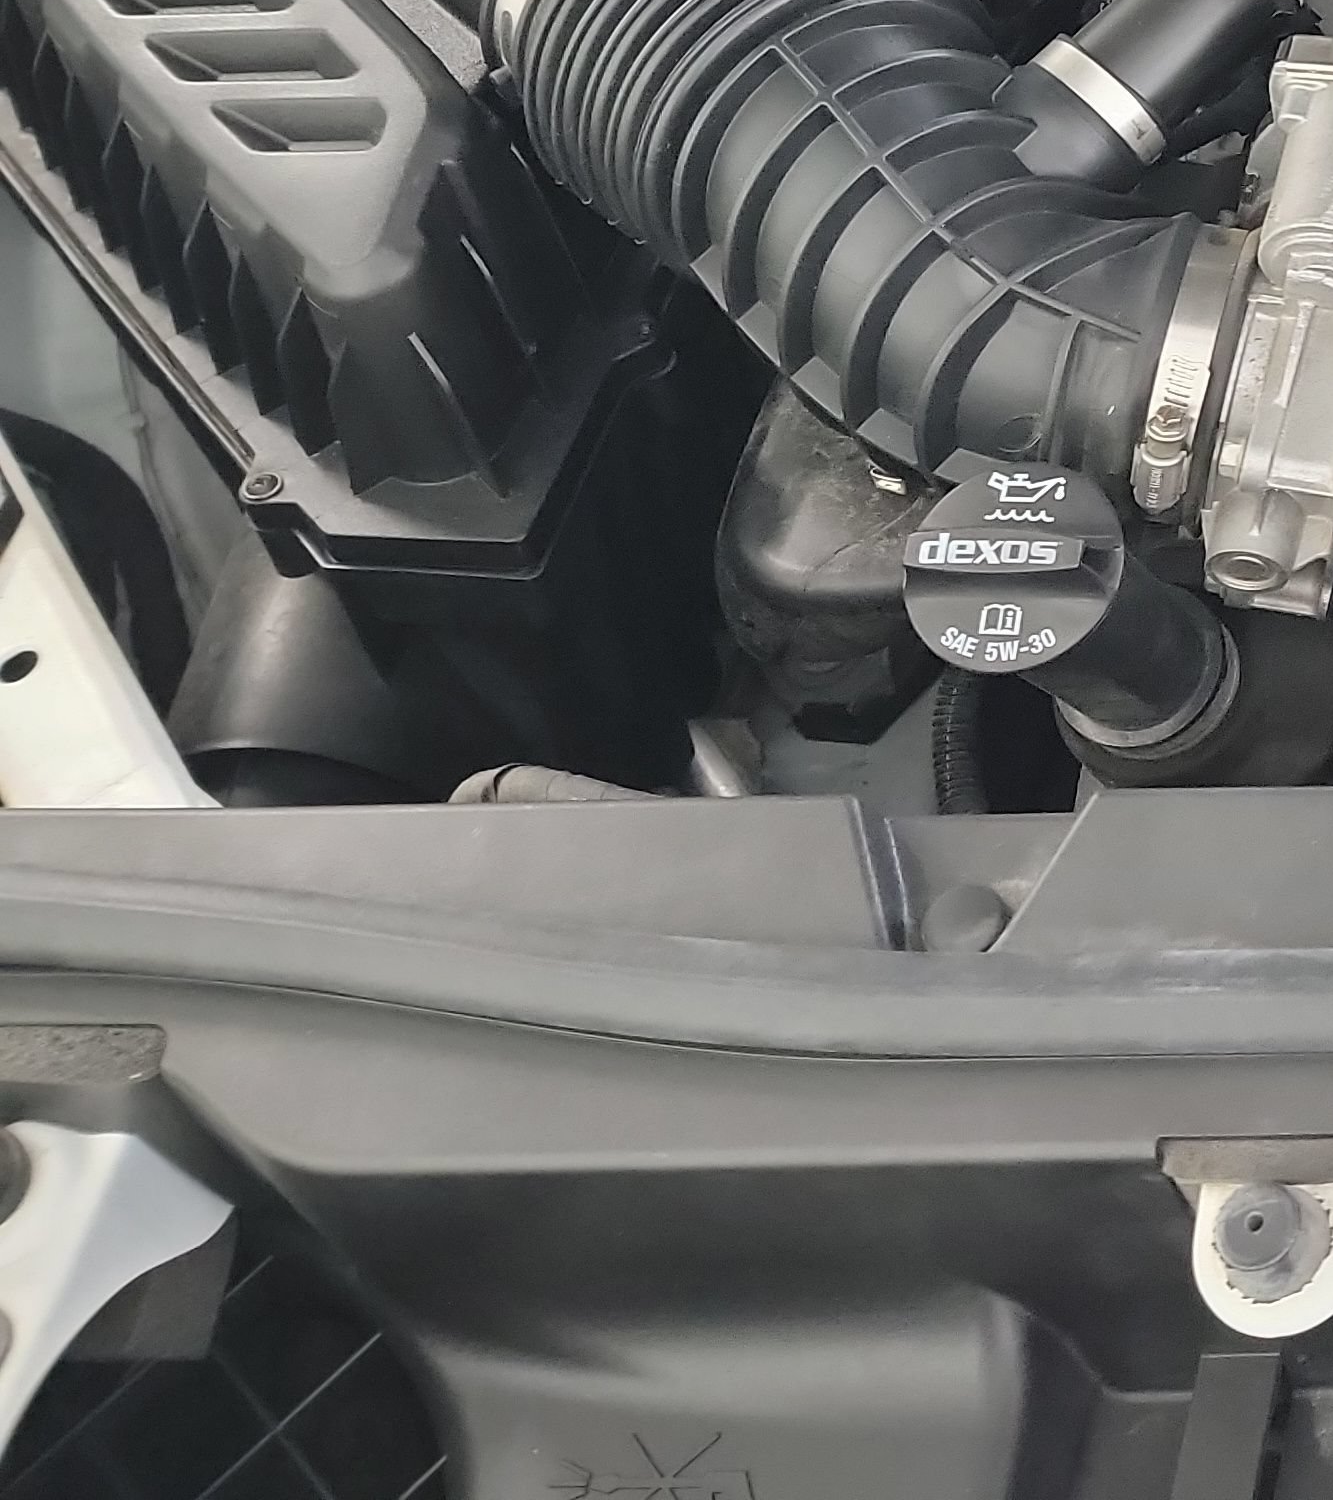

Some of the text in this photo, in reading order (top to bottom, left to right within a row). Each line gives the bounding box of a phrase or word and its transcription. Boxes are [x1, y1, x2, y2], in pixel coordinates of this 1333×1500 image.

[918, 532, 1058, 565] dexos
[940, 627, 1056, 662] SAE 5W-30
